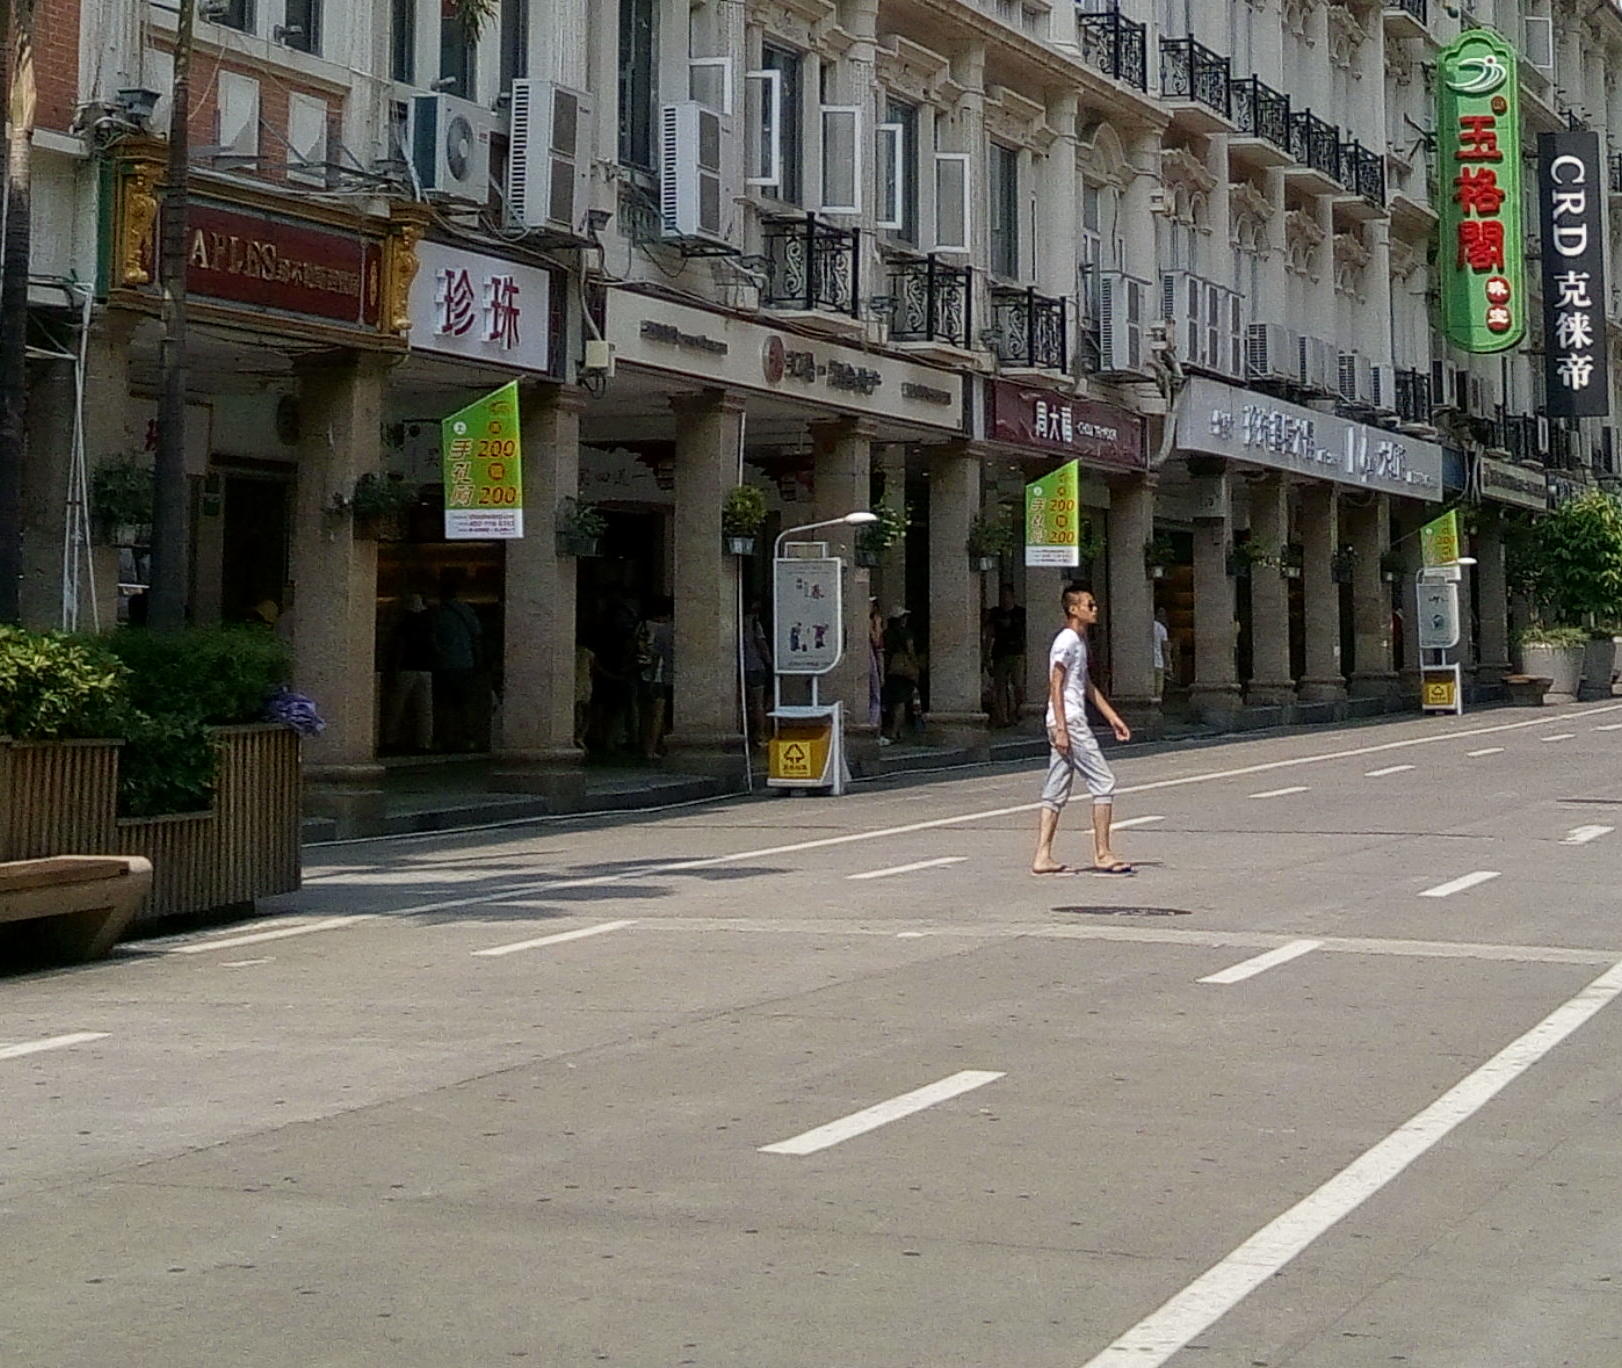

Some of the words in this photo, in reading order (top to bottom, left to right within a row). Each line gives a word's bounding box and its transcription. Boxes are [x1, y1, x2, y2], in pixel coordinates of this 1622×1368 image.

[1550, 154, 1589, 258] CRD
[187, 229, 278, 281] APLES
[434, 268, 521, 350] 珍珠
[1553, 270, 1594, 392] 克徕帝
[477, 439, 516, 458] 200
[478, 486, 517, 505] 200
[1048, 498, 1075, 512] 200
[1048, 530, 1075, 544] 200
